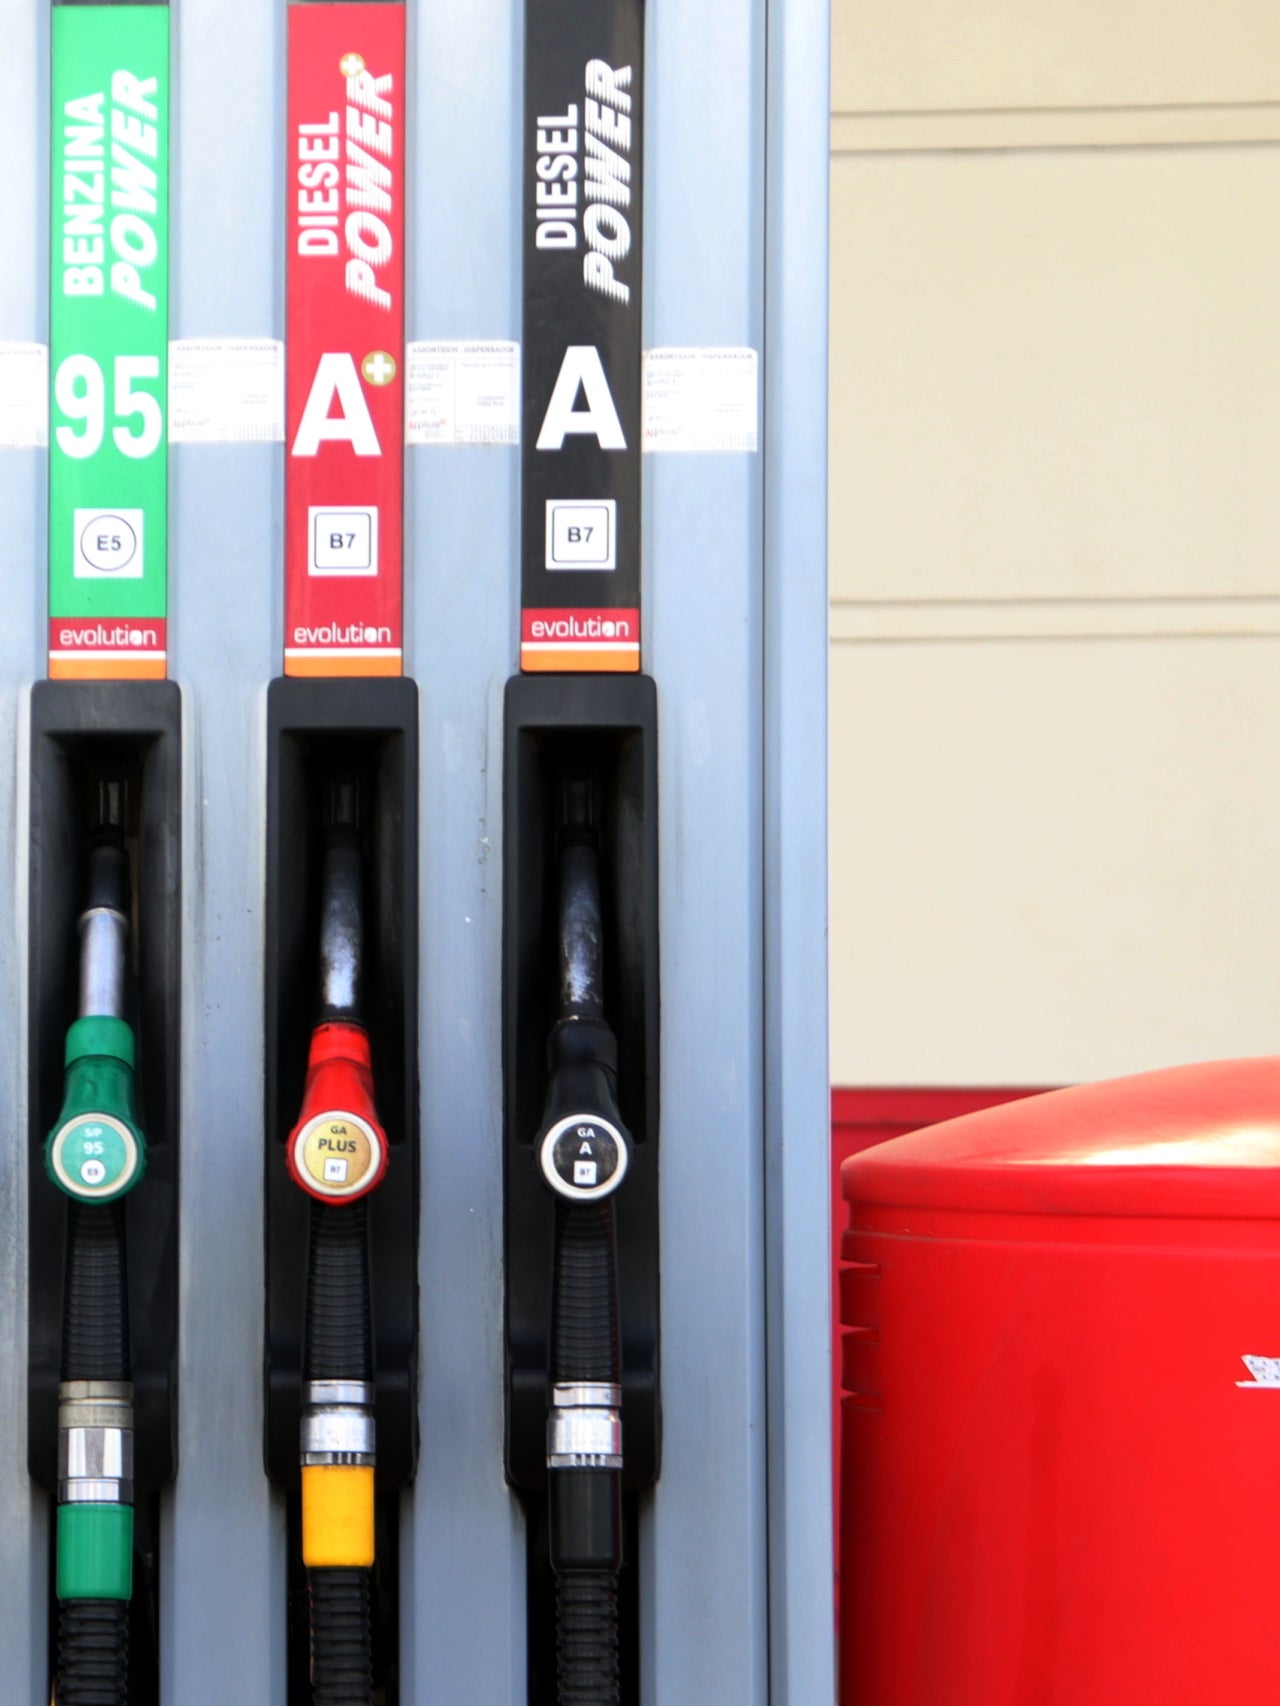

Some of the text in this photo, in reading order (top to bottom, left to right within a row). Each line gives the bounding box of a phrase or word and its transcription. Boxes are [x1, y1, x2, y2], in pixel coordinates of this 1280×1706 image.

[298, 111, 339, 256] DIESEL
[536, 103, 578, 250] DIESEL
[583, 59, 632, 306] POWER
[63, 92, 105, 295] BENZINA
[110, 69, 158, 313] POWER
[55, 354, 162, 459] 95
[535, 345, 628, 450] A
[96, 534, 121, 551] E5
[329, 533, 356, 549] B7
[567, 527, 594, 543] B7
[59, 625, 157, 647] evolution
[293, 622, 391, 644] evolution
[530, 617, 629, 639] evolution
[330, 1126, 347, 1135] GA
[577, 1128, 596, 1138] GA
[83, 1142, 104, 1155] 95
[318, 1138, 357, 1153] PLUS
[579, 1141, 592, 1155] A
